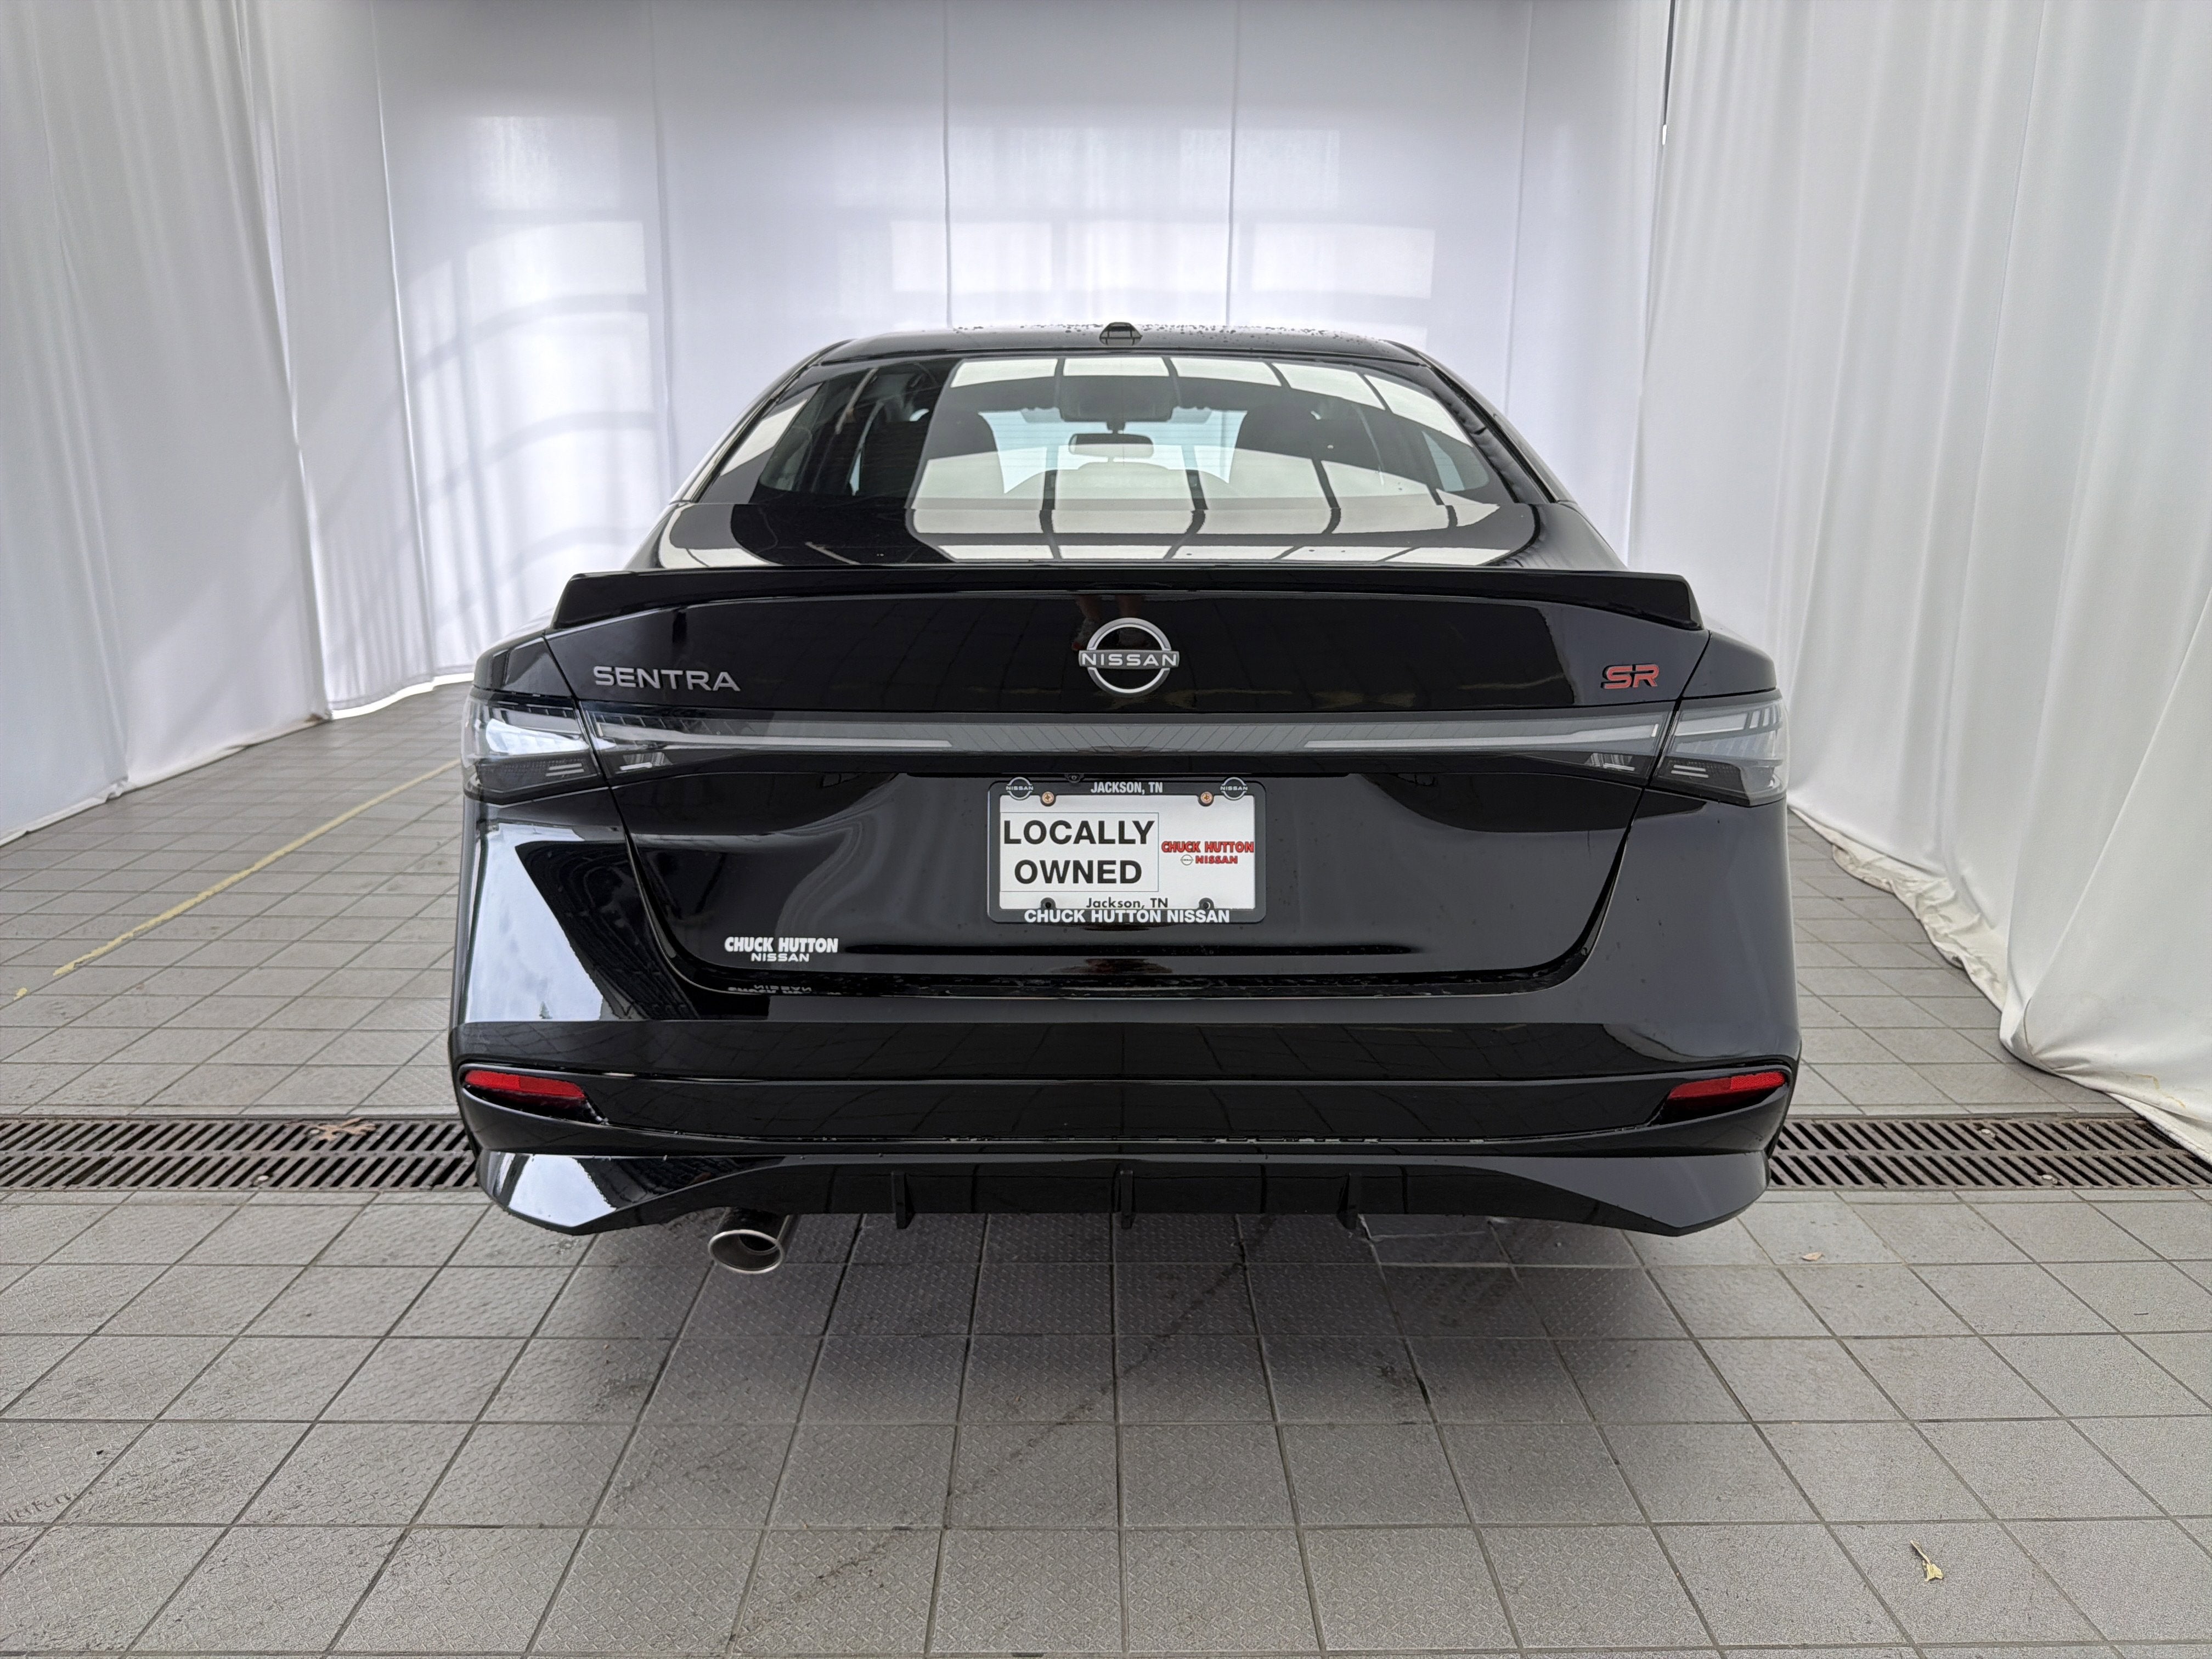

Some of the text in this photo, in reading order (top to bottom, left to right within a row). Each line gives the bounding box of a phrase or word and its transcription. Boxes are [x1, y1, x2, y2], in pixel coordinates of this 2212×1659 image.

[1082, 653, 1177, 666] NISSAN
[593, 665, 741, 692] SENTRA
[1604, 664, 1659, 689] SR
[1090, 781, 1163, 795] JACKSON, TN
[1004, 820, 1155, 845] LOCALLY
[1161, 840, 1255, 853] CHUCK HUTTON
[1195, 855, 1238, 864] NISSAN
[1014, 860, 1142, 884] OWNED
[1086, 896, 1168, 909] Jackson, TN
[1024, 909, 1230, 923] CHUCK HUTTON NISSAN
[725, 936, 839, 953] CHUCK HUTTON
[751, 953, 810, 962] NISSAN
